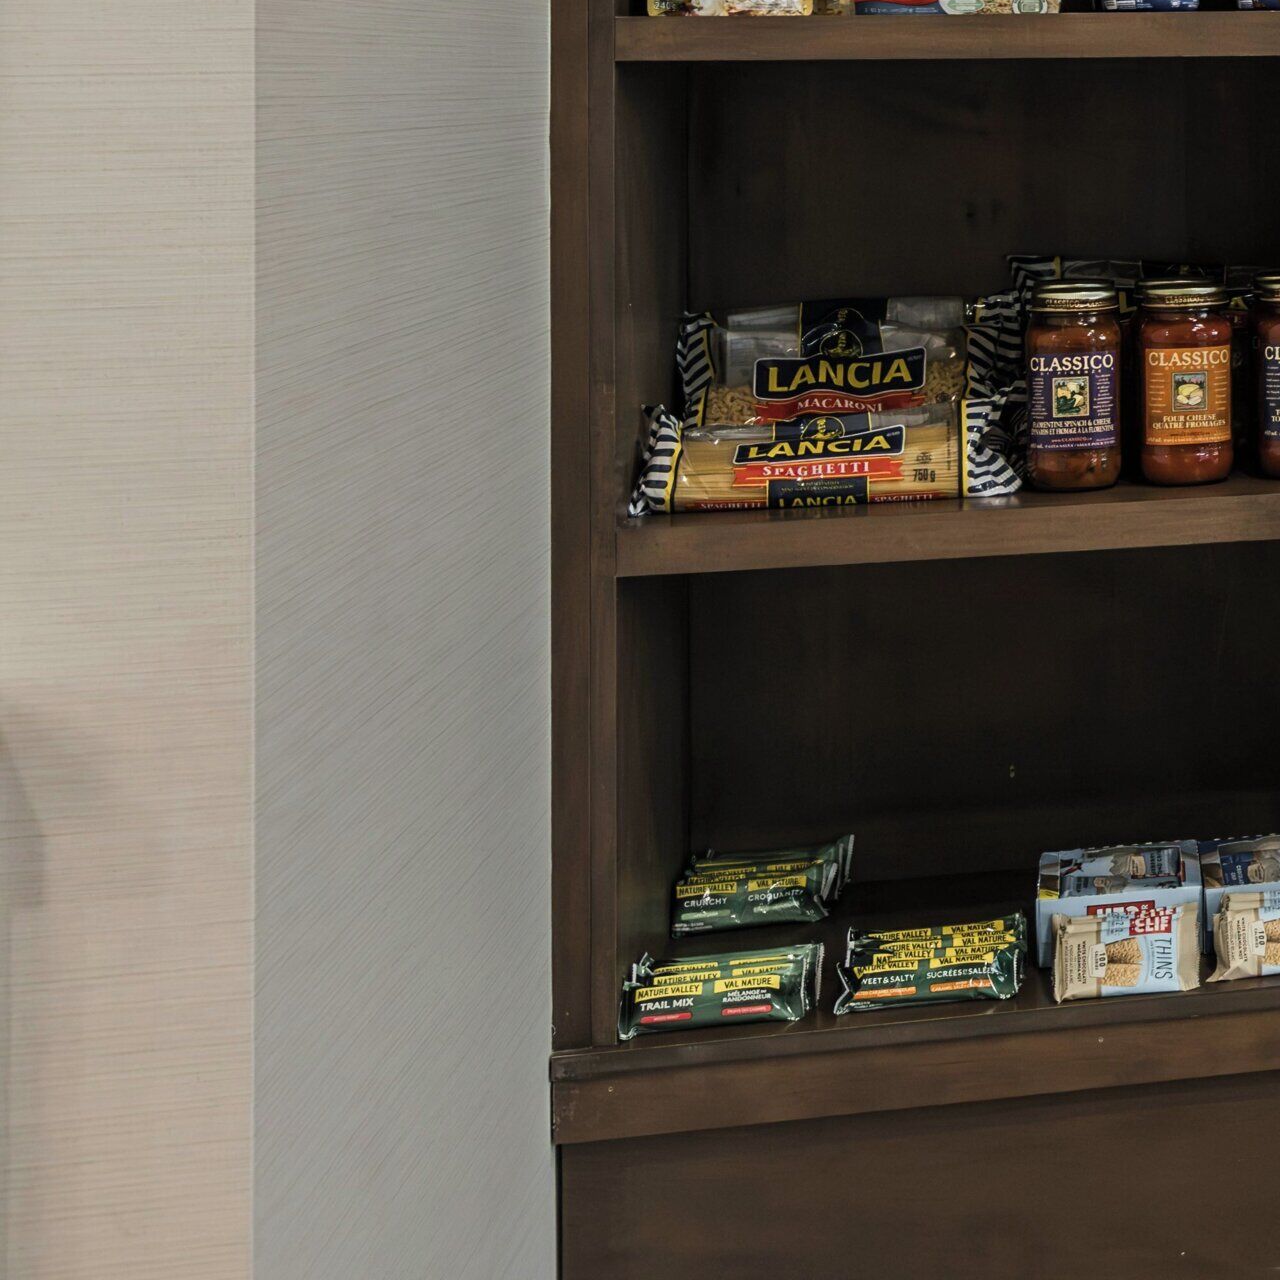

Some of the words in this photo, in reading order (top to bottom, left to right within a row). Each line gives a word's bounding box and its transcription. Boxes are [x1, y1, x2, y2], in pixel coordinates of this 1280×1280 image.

[1030, 354, 1114, 371] CLASSICO
[1149, 350, 1229, 366] CLASSICO
[768, 359, 912, 394] LANCIA
[797, 397, 882, 413] MACARONI
[1185, 419, 1225, 428] FROMAGES
[748, 434, 892, 459] LANCIA
[762, 461, 871, 478] SPAGHETTI
[913, 468, 928, 482] 750
[680, 885, 708, 895] NATURE
[710, 883, 735, 892] VALLEY
[684, 898, 728, 908] CRUNCHY
[951, 925, 966, 933] VAL
[967, 922, 995, 931] NATURE
[1135, 916, 1170, 933] CLIF
[902, 929, 929, 938] VALLEY
[978, 935, 1007, 943] NATURE
[902, 949, 932, 958] VALLEY
[1154, 937, 1173, 979] THINS
[888, 961, 914, 969] VALLEY
[724, 980, 740, 988] VAL
[742, 977, 772, 986] NATURE
[890, 974, 915, 982] SALTY
[638, 989, 669, 999] NATURE
[671, 985, 700, 994] VALLEY
[722, 994, 771, 1003] RANDONNEUR
[640, 1002, 670, 1012] TRAIL
[672, 998, 694, 1008] MIX
